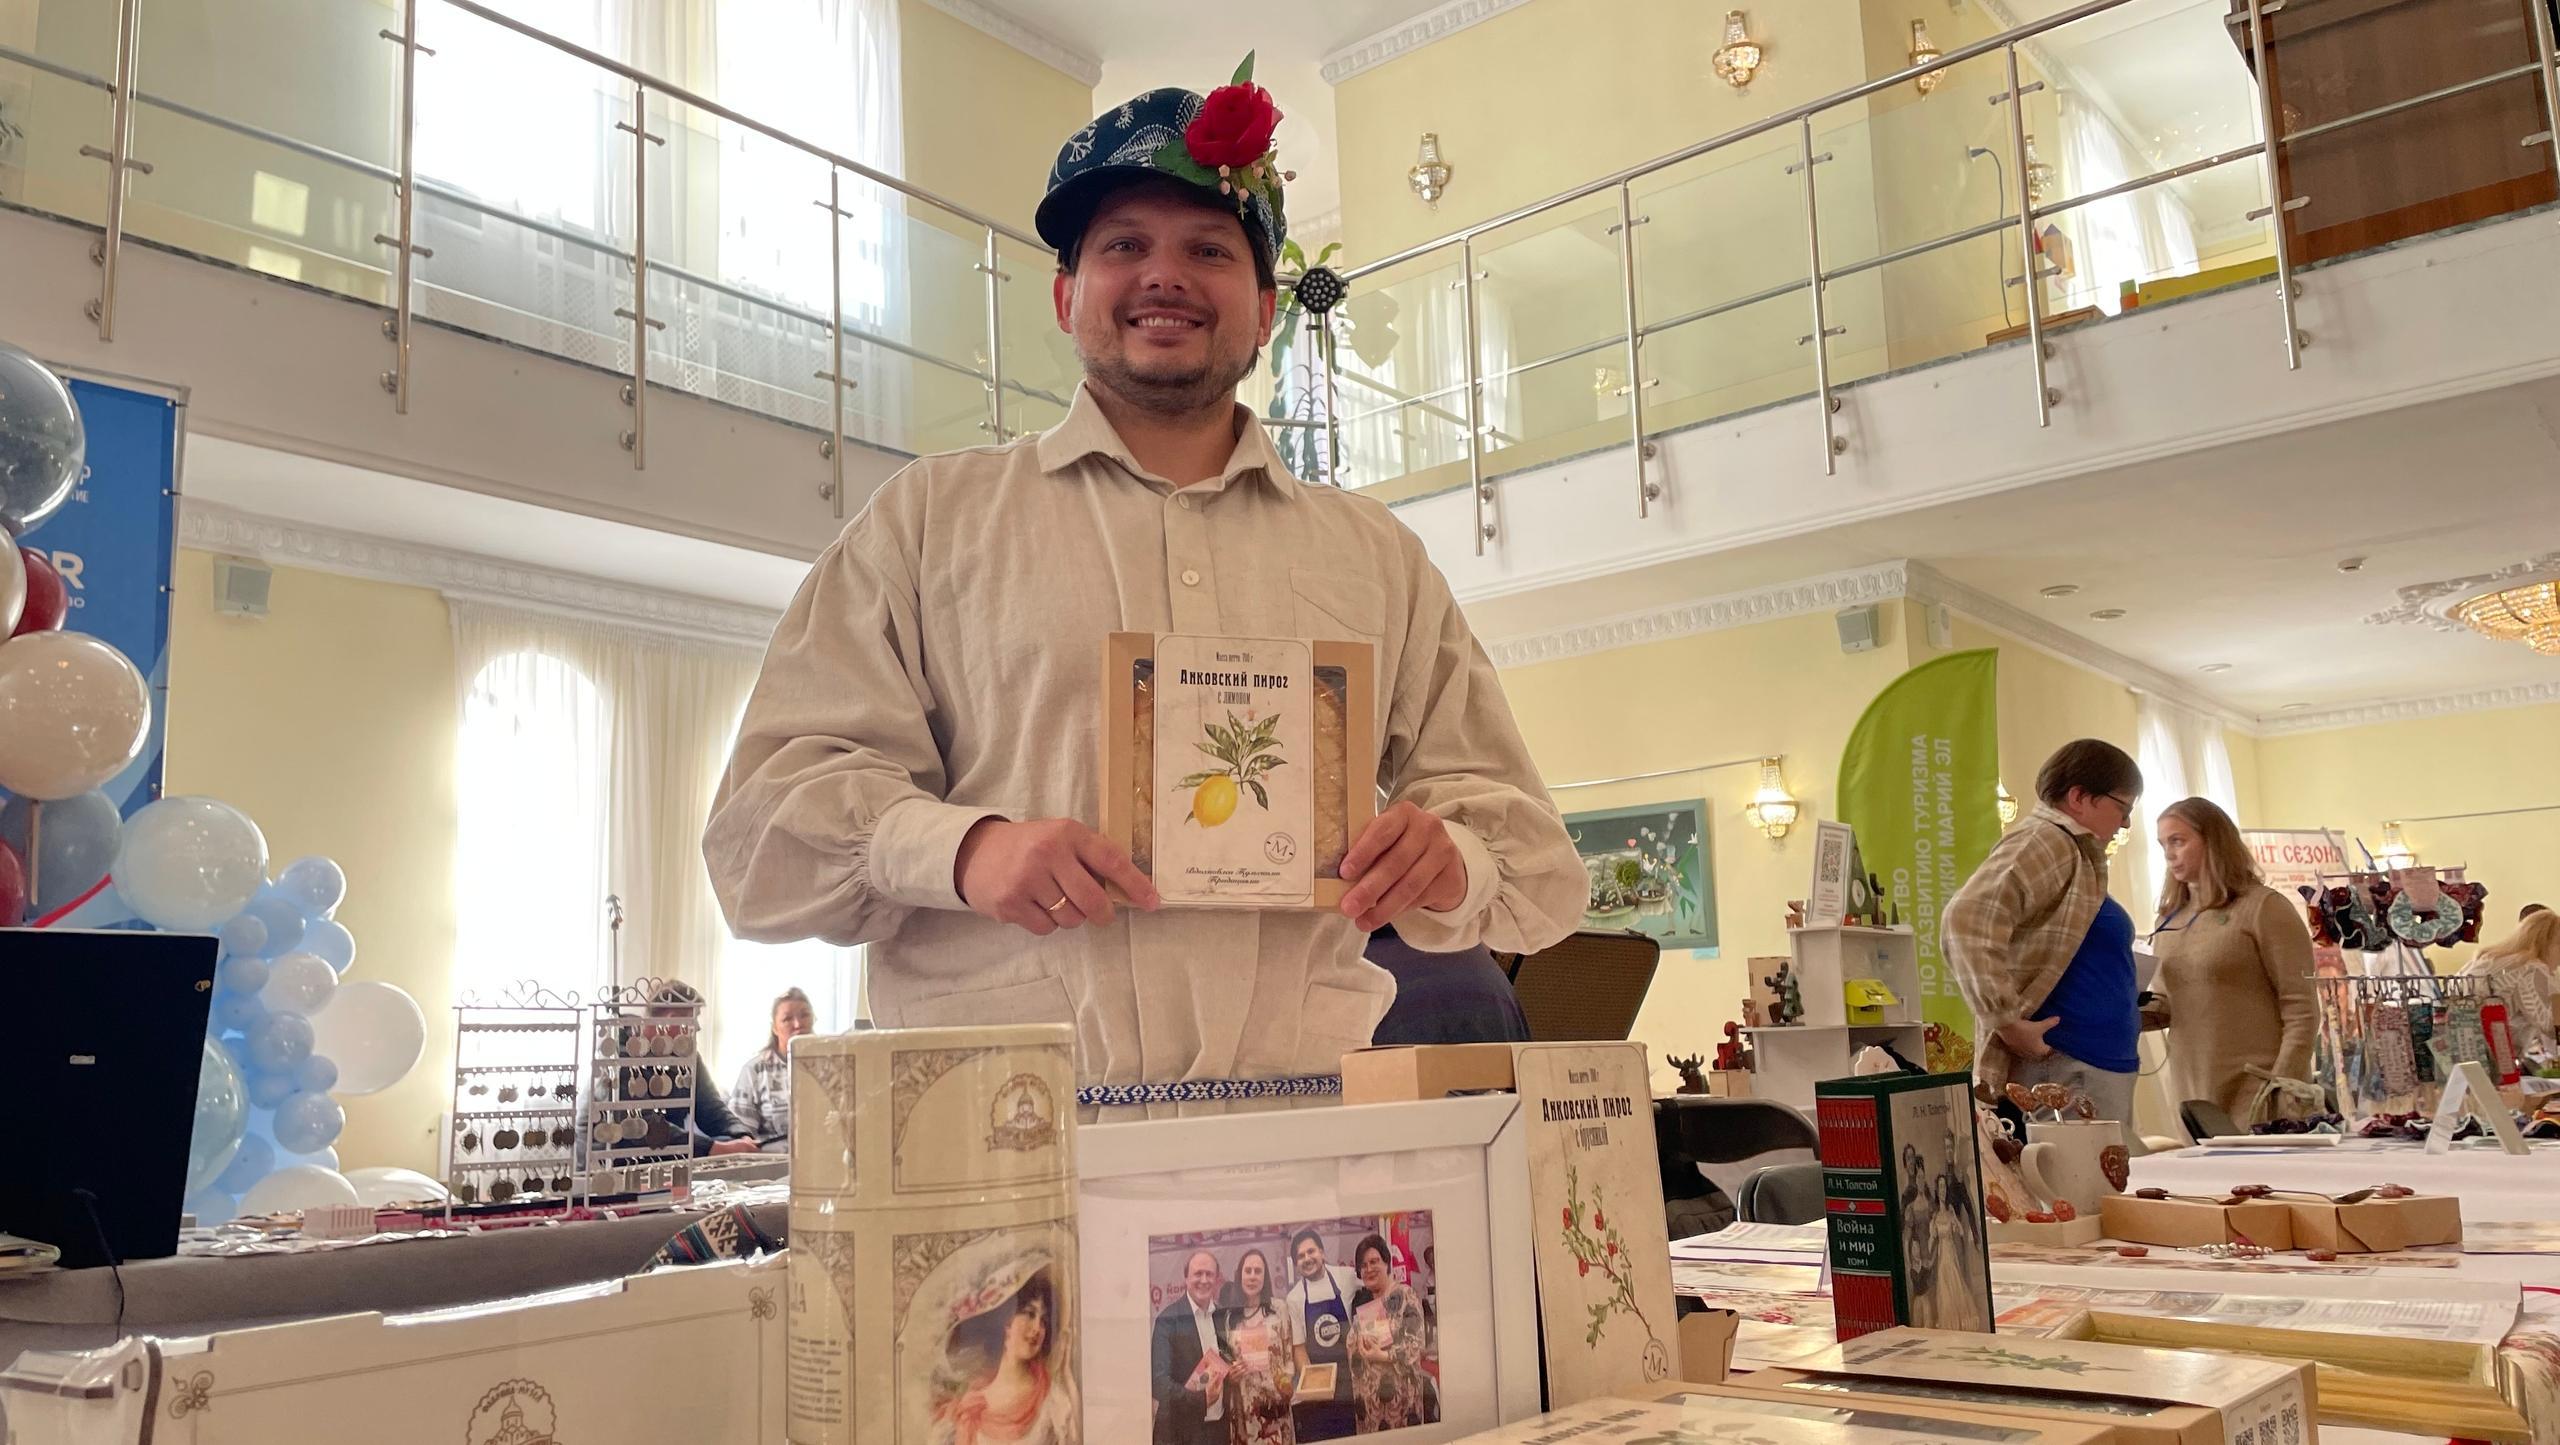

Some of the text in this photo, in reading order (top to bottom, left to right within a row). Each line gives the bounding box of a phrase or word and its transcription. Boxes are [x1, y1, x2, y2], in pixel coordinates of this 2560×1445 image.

[1180, 669, 1289, 689] Анковский пирог
[1934, 738, 1952, 766] ЭЛ
[1931, 771, 1956, 848] МАРИЙ
[1911, 733, 1938, 996] ПО РАЗВИТИЮ ТУРИЗМА
[1541, 1094, 1633, 1122] Анковский пирог
[1844, 1179, 1878, 1191] Толстой
[1836, 1218, 1875, 1235] Война
[1838, 1239, 1875, 1256] и мир
